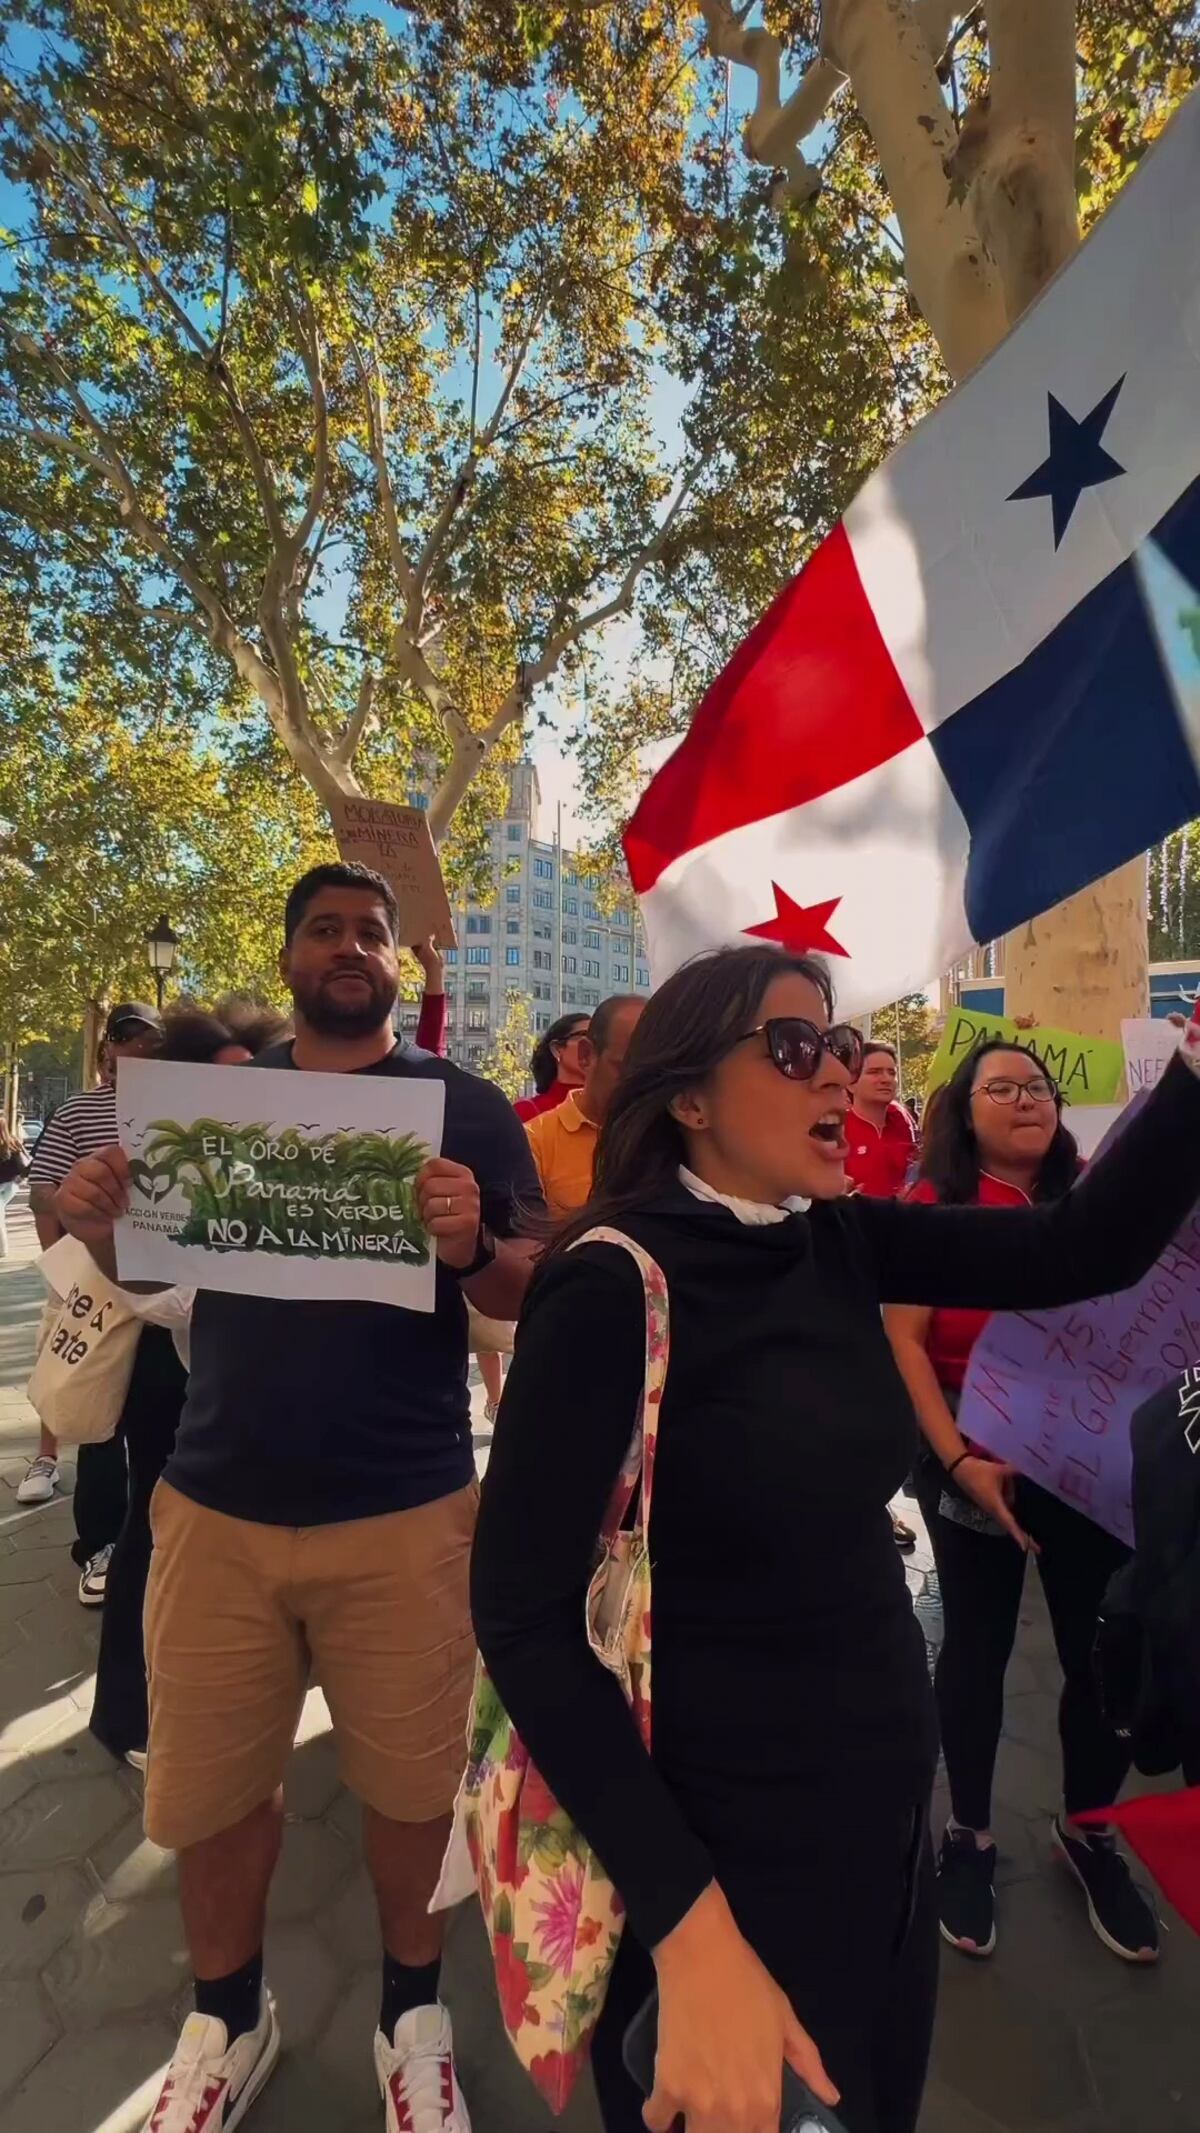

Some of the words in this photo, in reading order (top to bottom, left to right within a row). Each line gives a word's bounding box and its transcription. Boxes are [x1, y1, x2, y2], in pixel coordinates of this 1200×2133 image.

[203, 1136, 233, 1156] EL
[250, 1140, 298, 1160] ORO
[214, 1161, 361, 1203] Panamá
[287, 1203, 314, 1217] ES
[324, 1205, 404, 1220] VERDE
[208, 1218, 248, 1245] NO
[256, 1225, 284, 1246] A
[287, 1228, 320, 1247] LA
